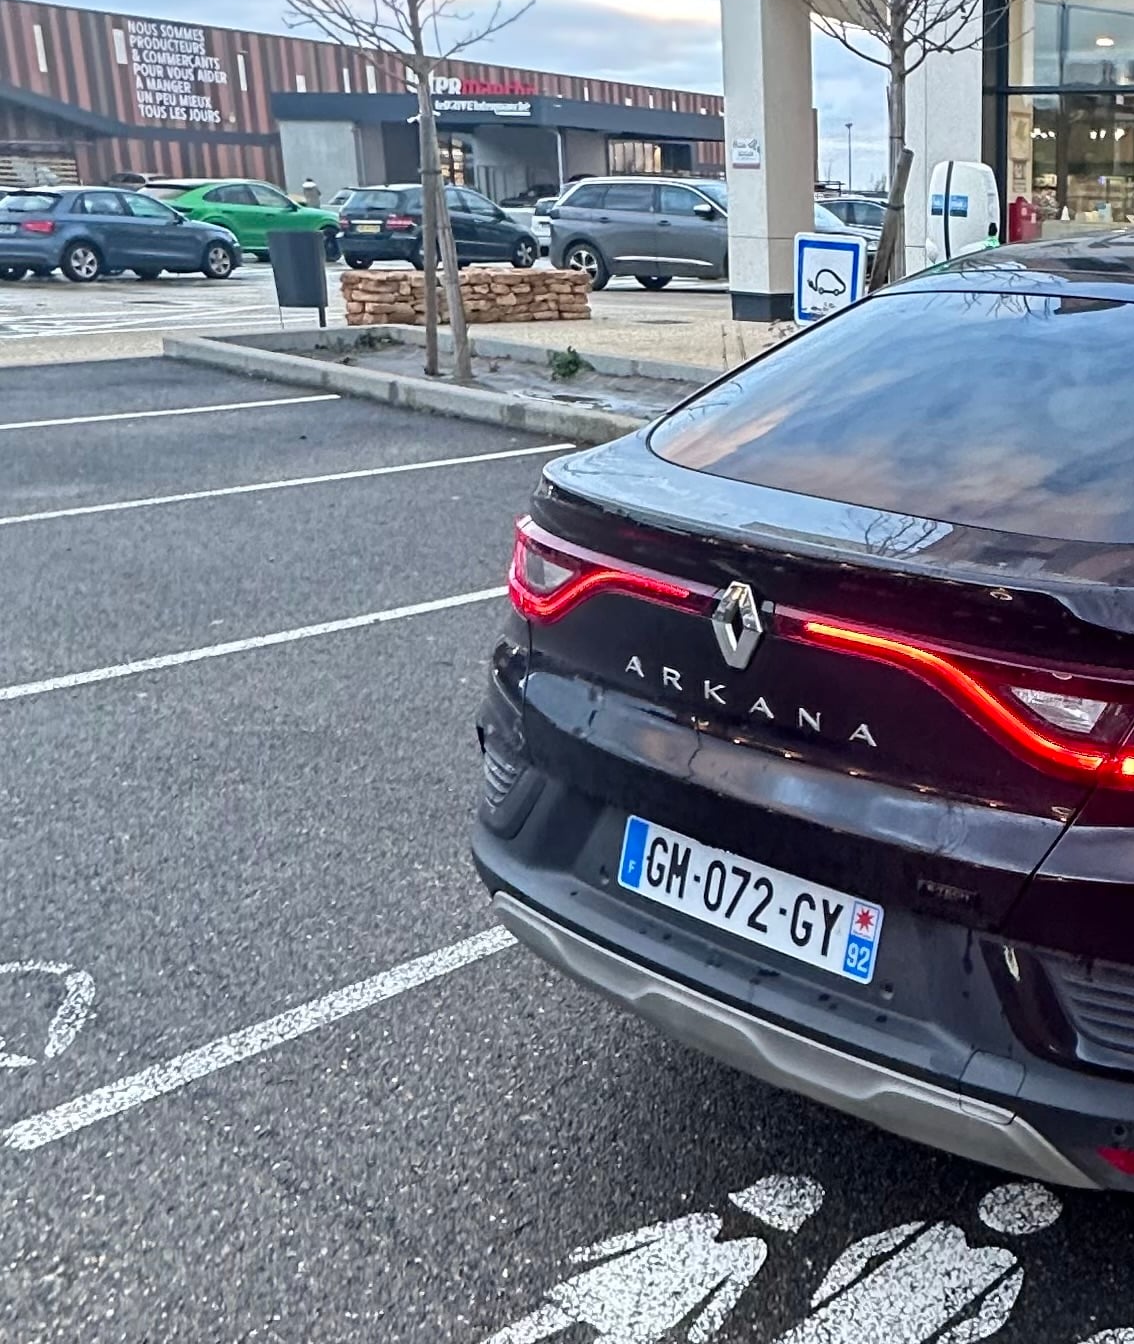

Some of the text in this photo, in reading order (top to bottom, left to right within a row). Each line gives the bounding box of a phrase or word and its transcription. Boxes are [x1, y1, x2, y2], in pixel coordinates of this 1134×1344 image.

[128, 20, 205, 43] NOUS SOMMES
[129, 34, 206, 56] PRODUCTEURS
[132, 49, 141, 62] &
[133, 62, 228, 85] POUR VOUS AIDER
[146, 77, 192, 94] MANGER
[136, 90, 212, 110] UN PEU MIEUX
[138, 103, 222, 125] TOUS LES JOURS
[625, 656, 877, 747] ARKANA
[627, 836, 871, 974] F GM-072-GY 92
